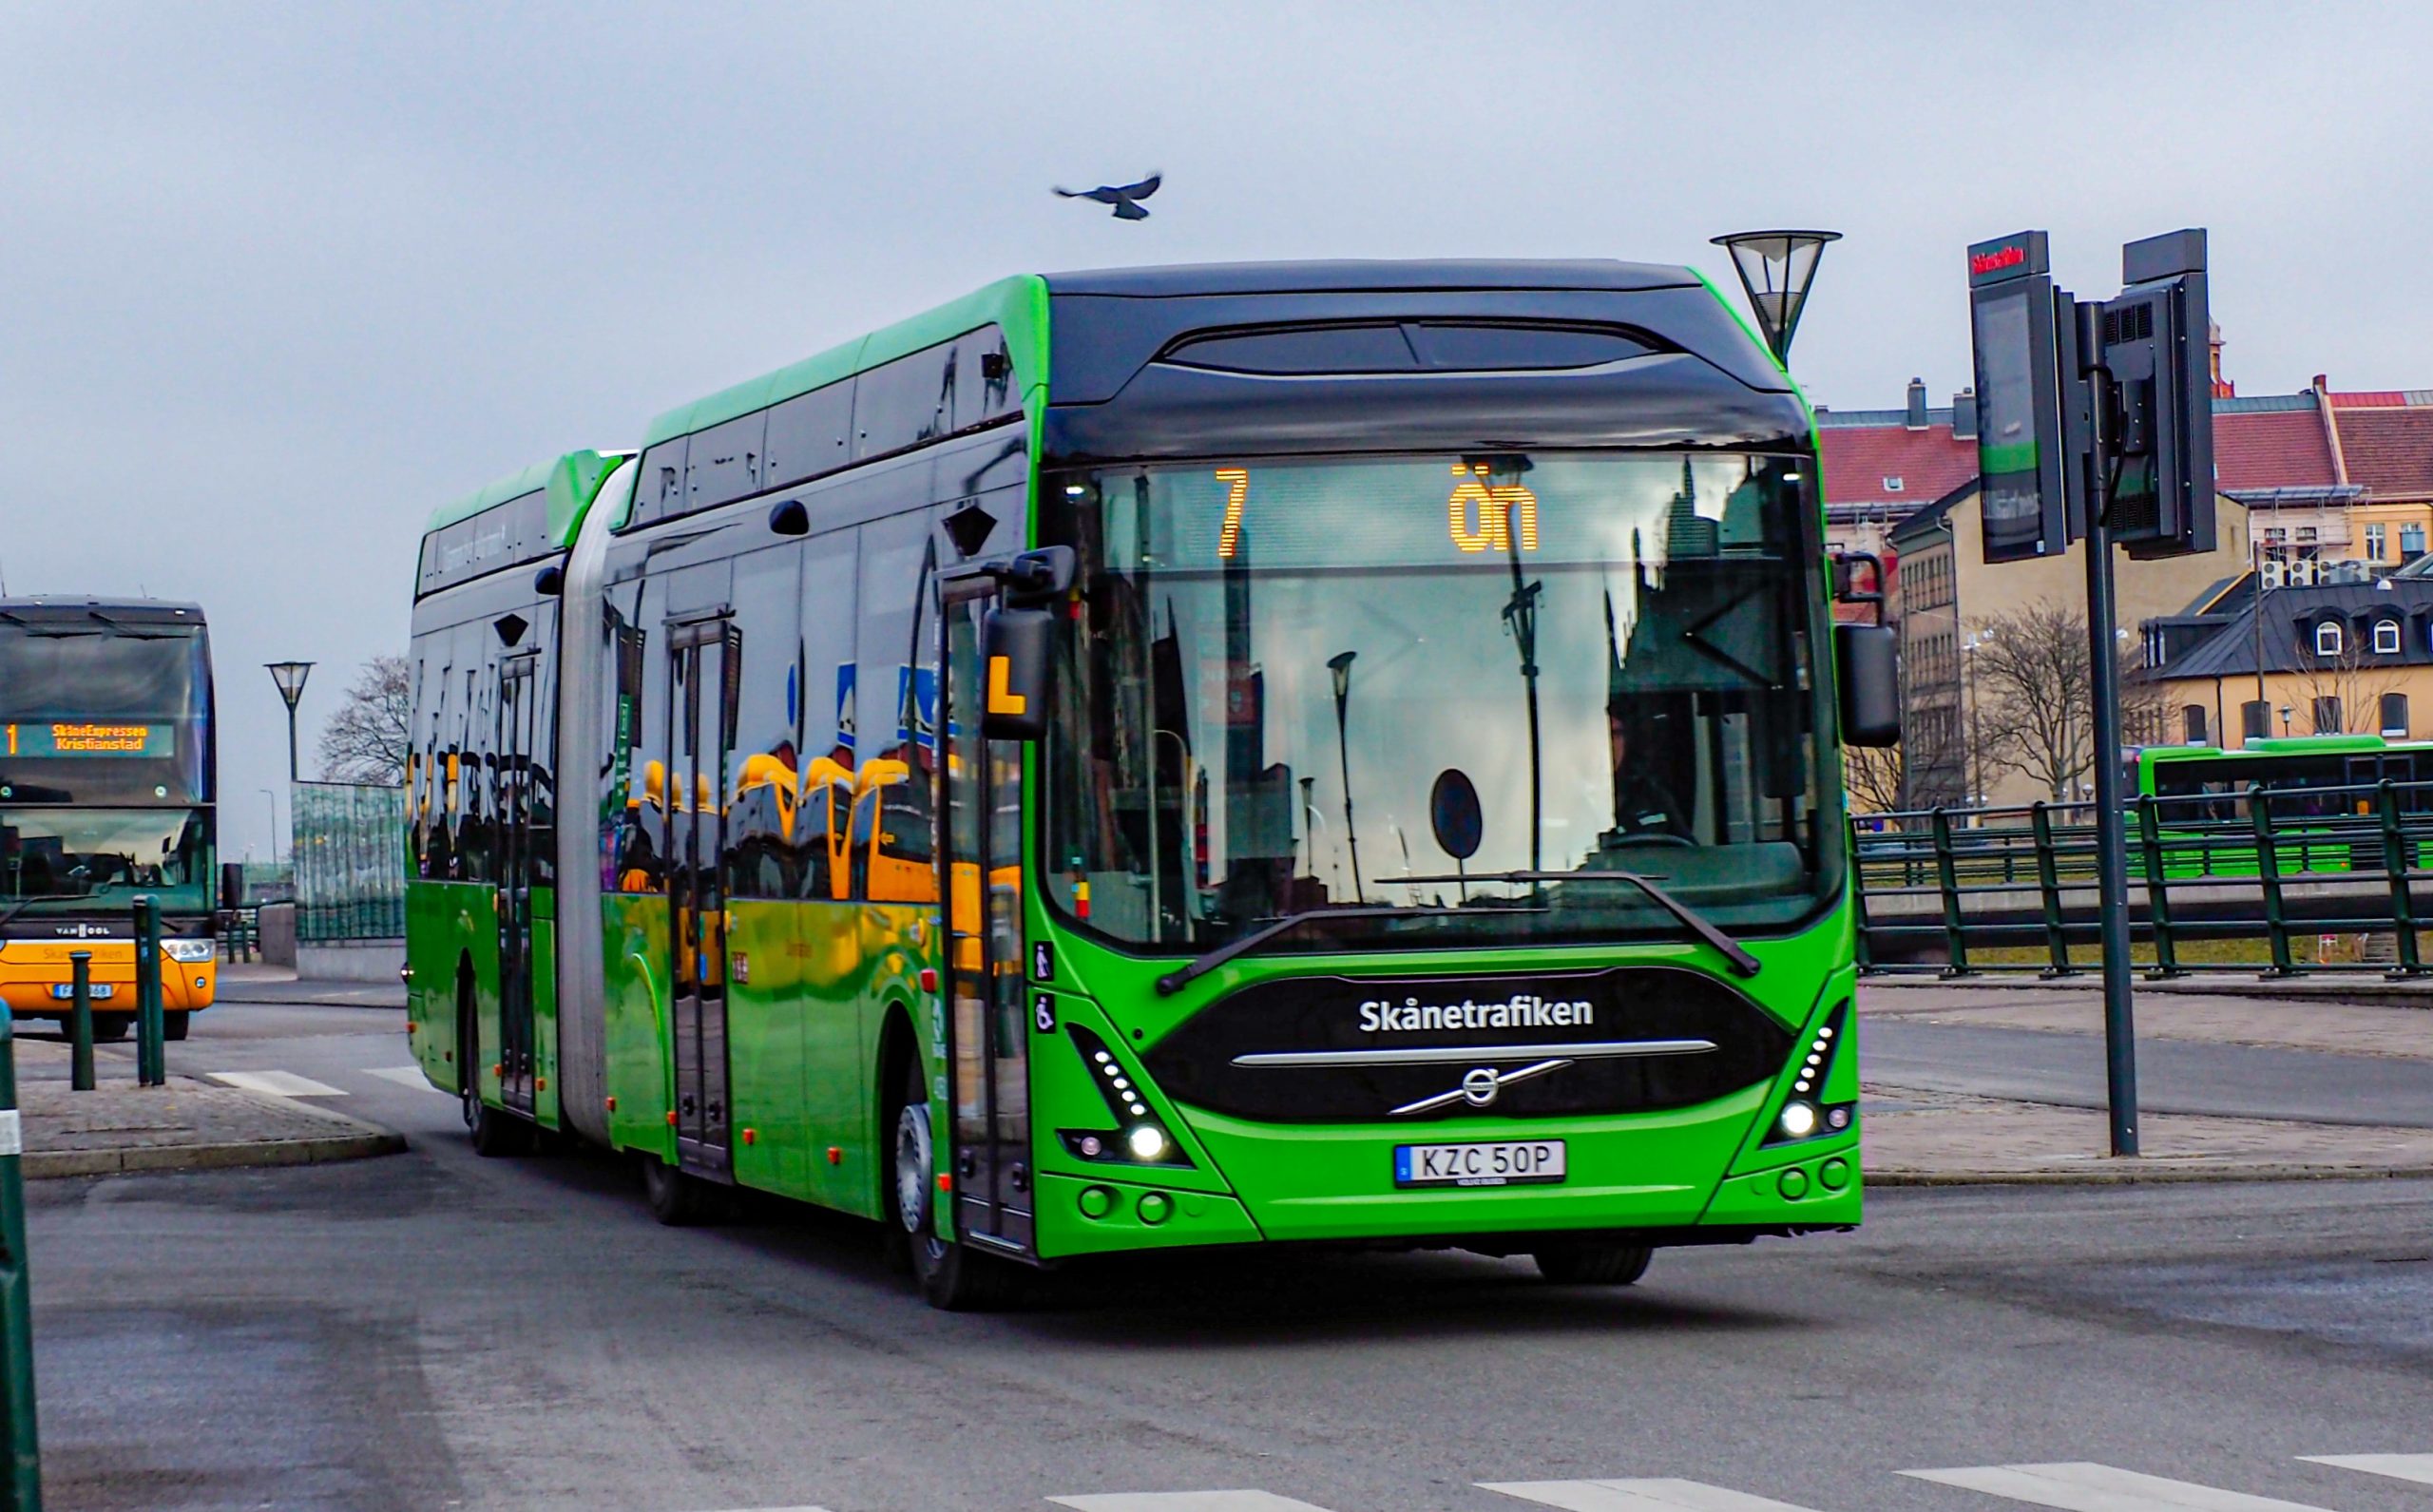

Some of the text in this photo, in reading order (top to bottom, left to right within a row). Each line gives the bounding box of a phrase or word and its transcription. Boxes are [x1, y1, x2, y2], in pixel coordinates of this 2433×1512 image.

[1216, 469, 1248, 557] 7
[8, 723, 17, 756] 1
[56, 738, 144, 751] Kristianstad
[1359, 996, 1594, 1032] Skånetrafiken
[1422, 1148, 1483, 1177] KZC
[1493, 1145, 1550, 1174] 50P
